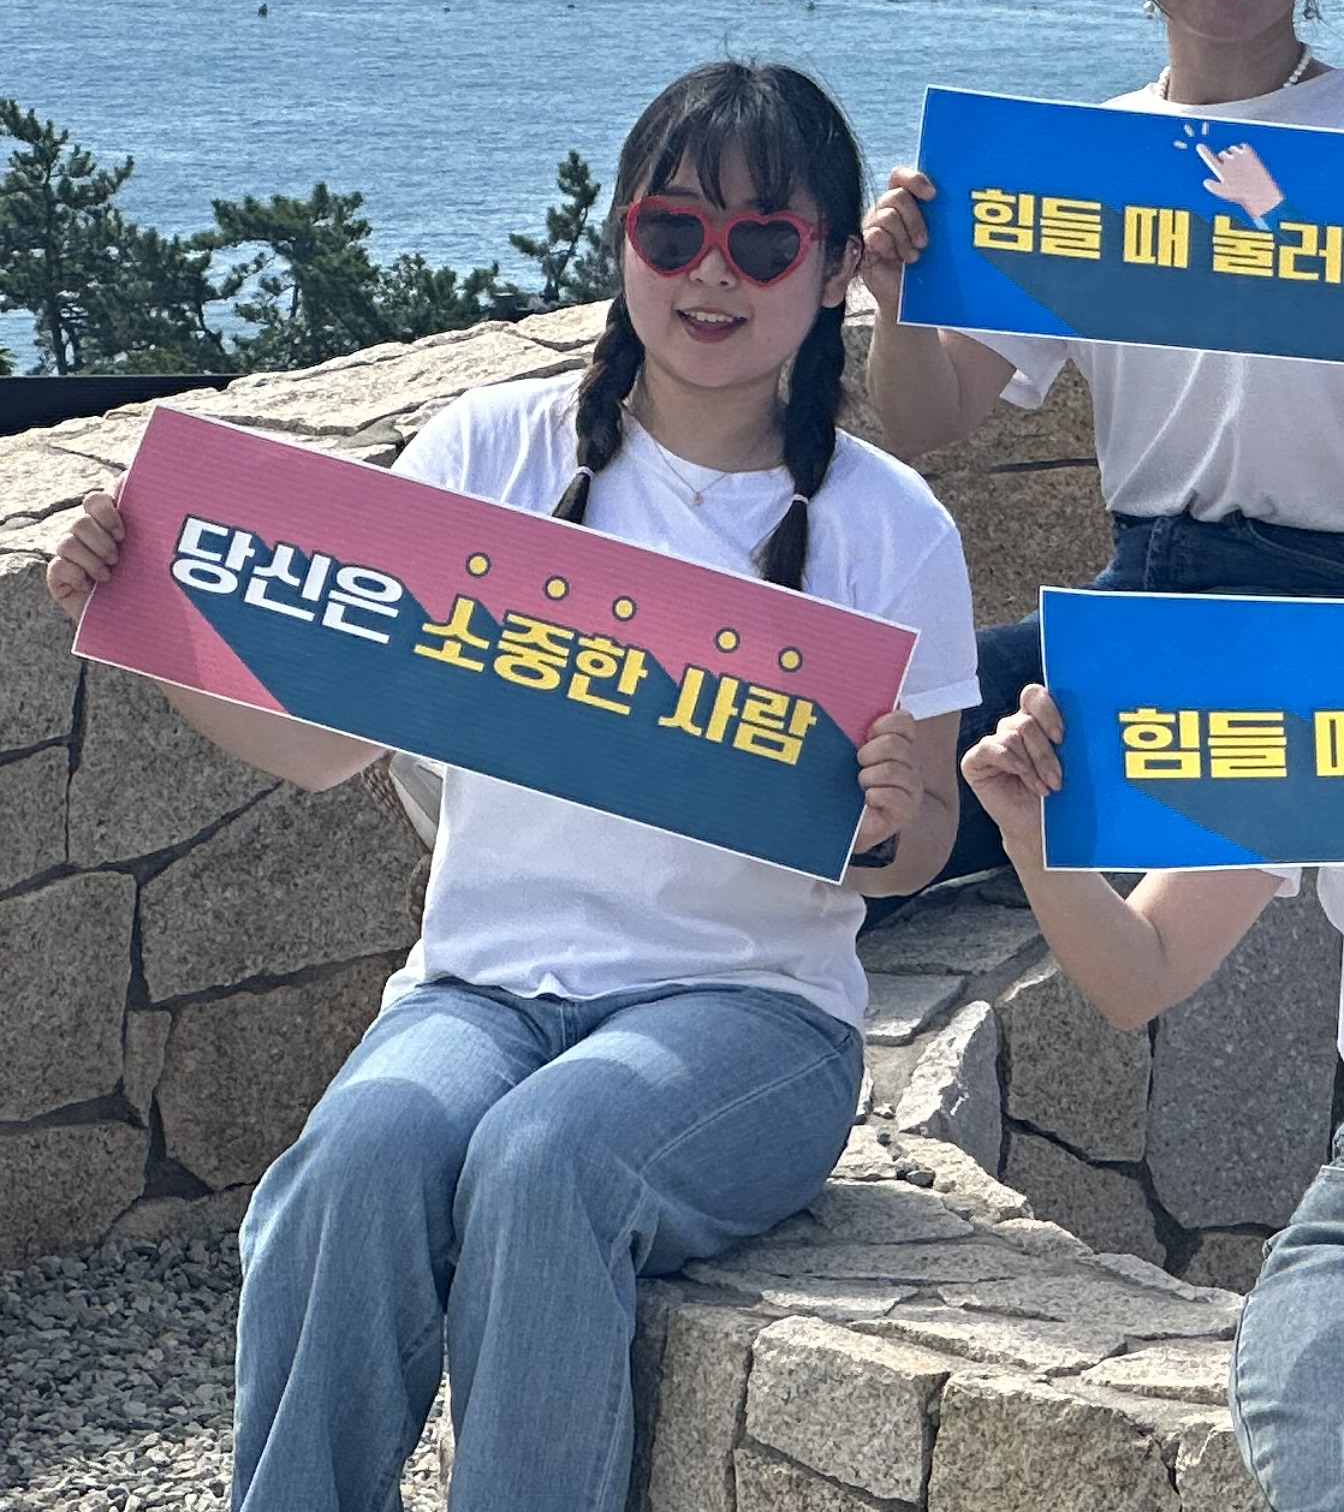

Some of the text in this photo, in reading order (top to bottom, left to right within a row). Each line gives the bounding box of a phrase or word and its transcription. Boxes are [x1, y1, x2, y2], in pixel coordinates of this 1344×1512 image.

[971, 189, 1102, 260] 힘들
[1123, 206, 1190, 269] 때
[171, 516, 818, 765] 당신은 소중한 사람
[1119, 708, 1288, 780] 힘들
